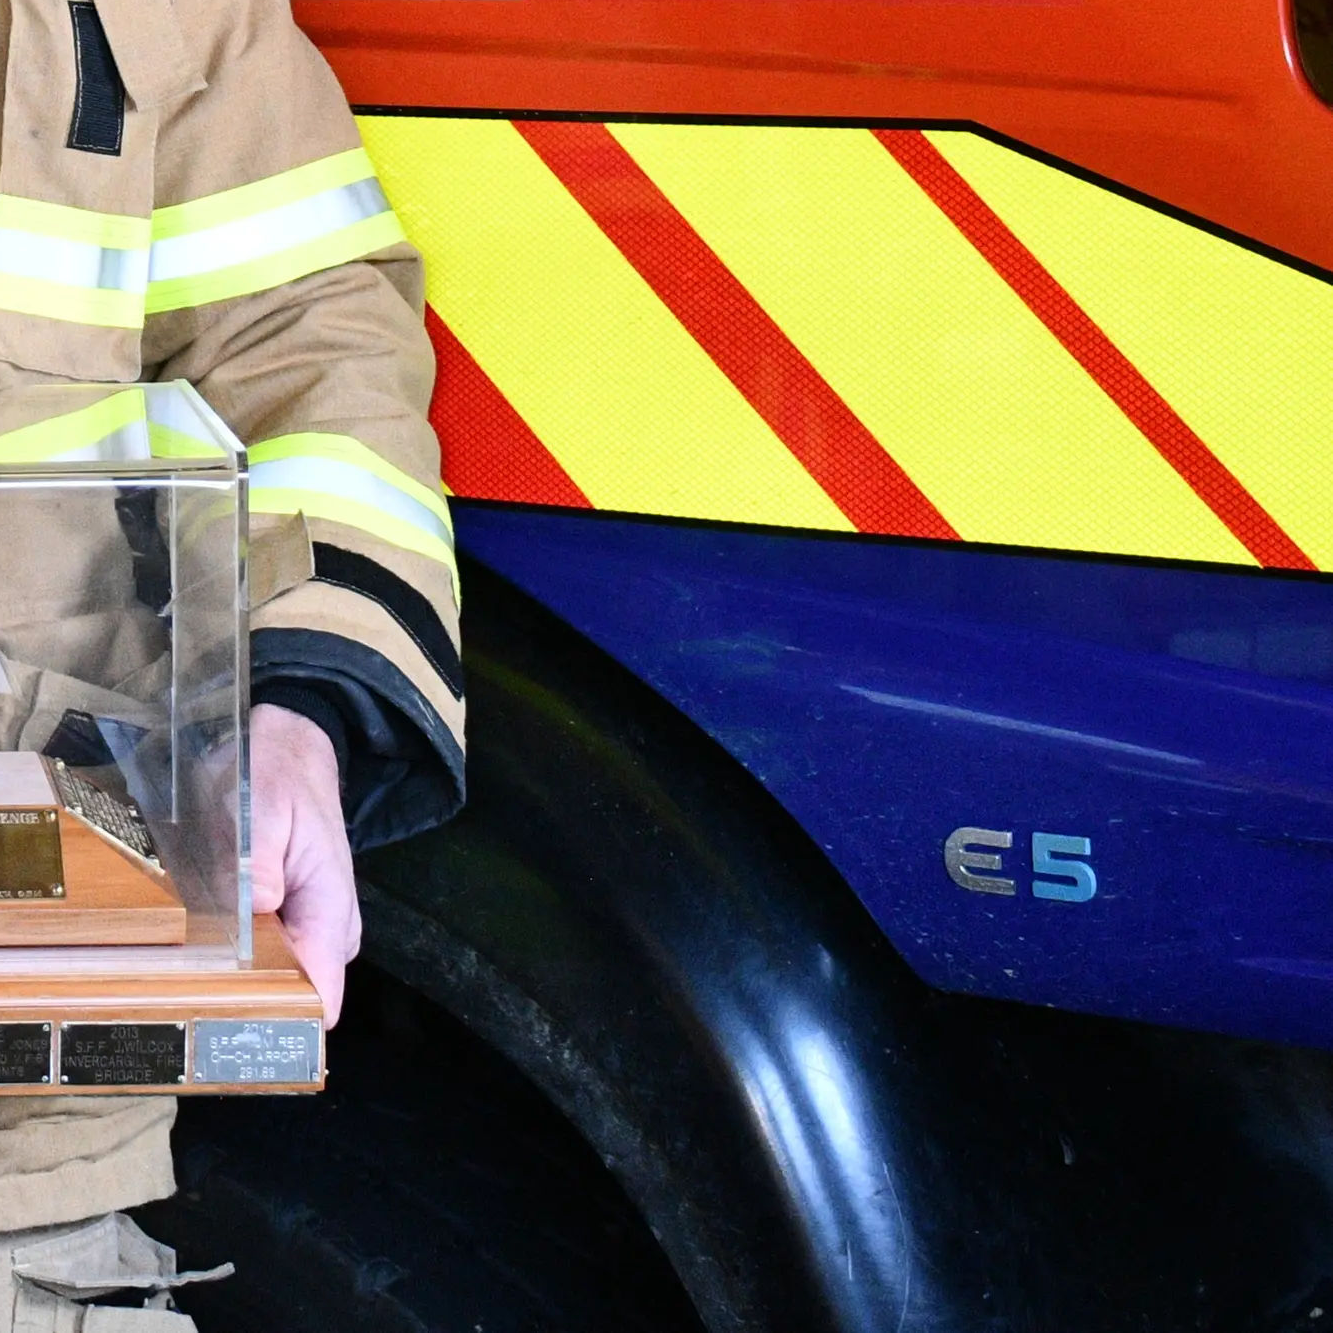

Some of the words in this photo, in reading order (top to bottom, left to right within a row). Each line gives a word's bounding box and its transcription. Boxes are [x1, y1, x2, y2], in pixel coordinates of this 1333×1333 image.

[110, 1027, 140, 1039] 2013
[156, 1055, 184, 1068] FIRE
[95, 1069, 154, 1083] BRIGADE
